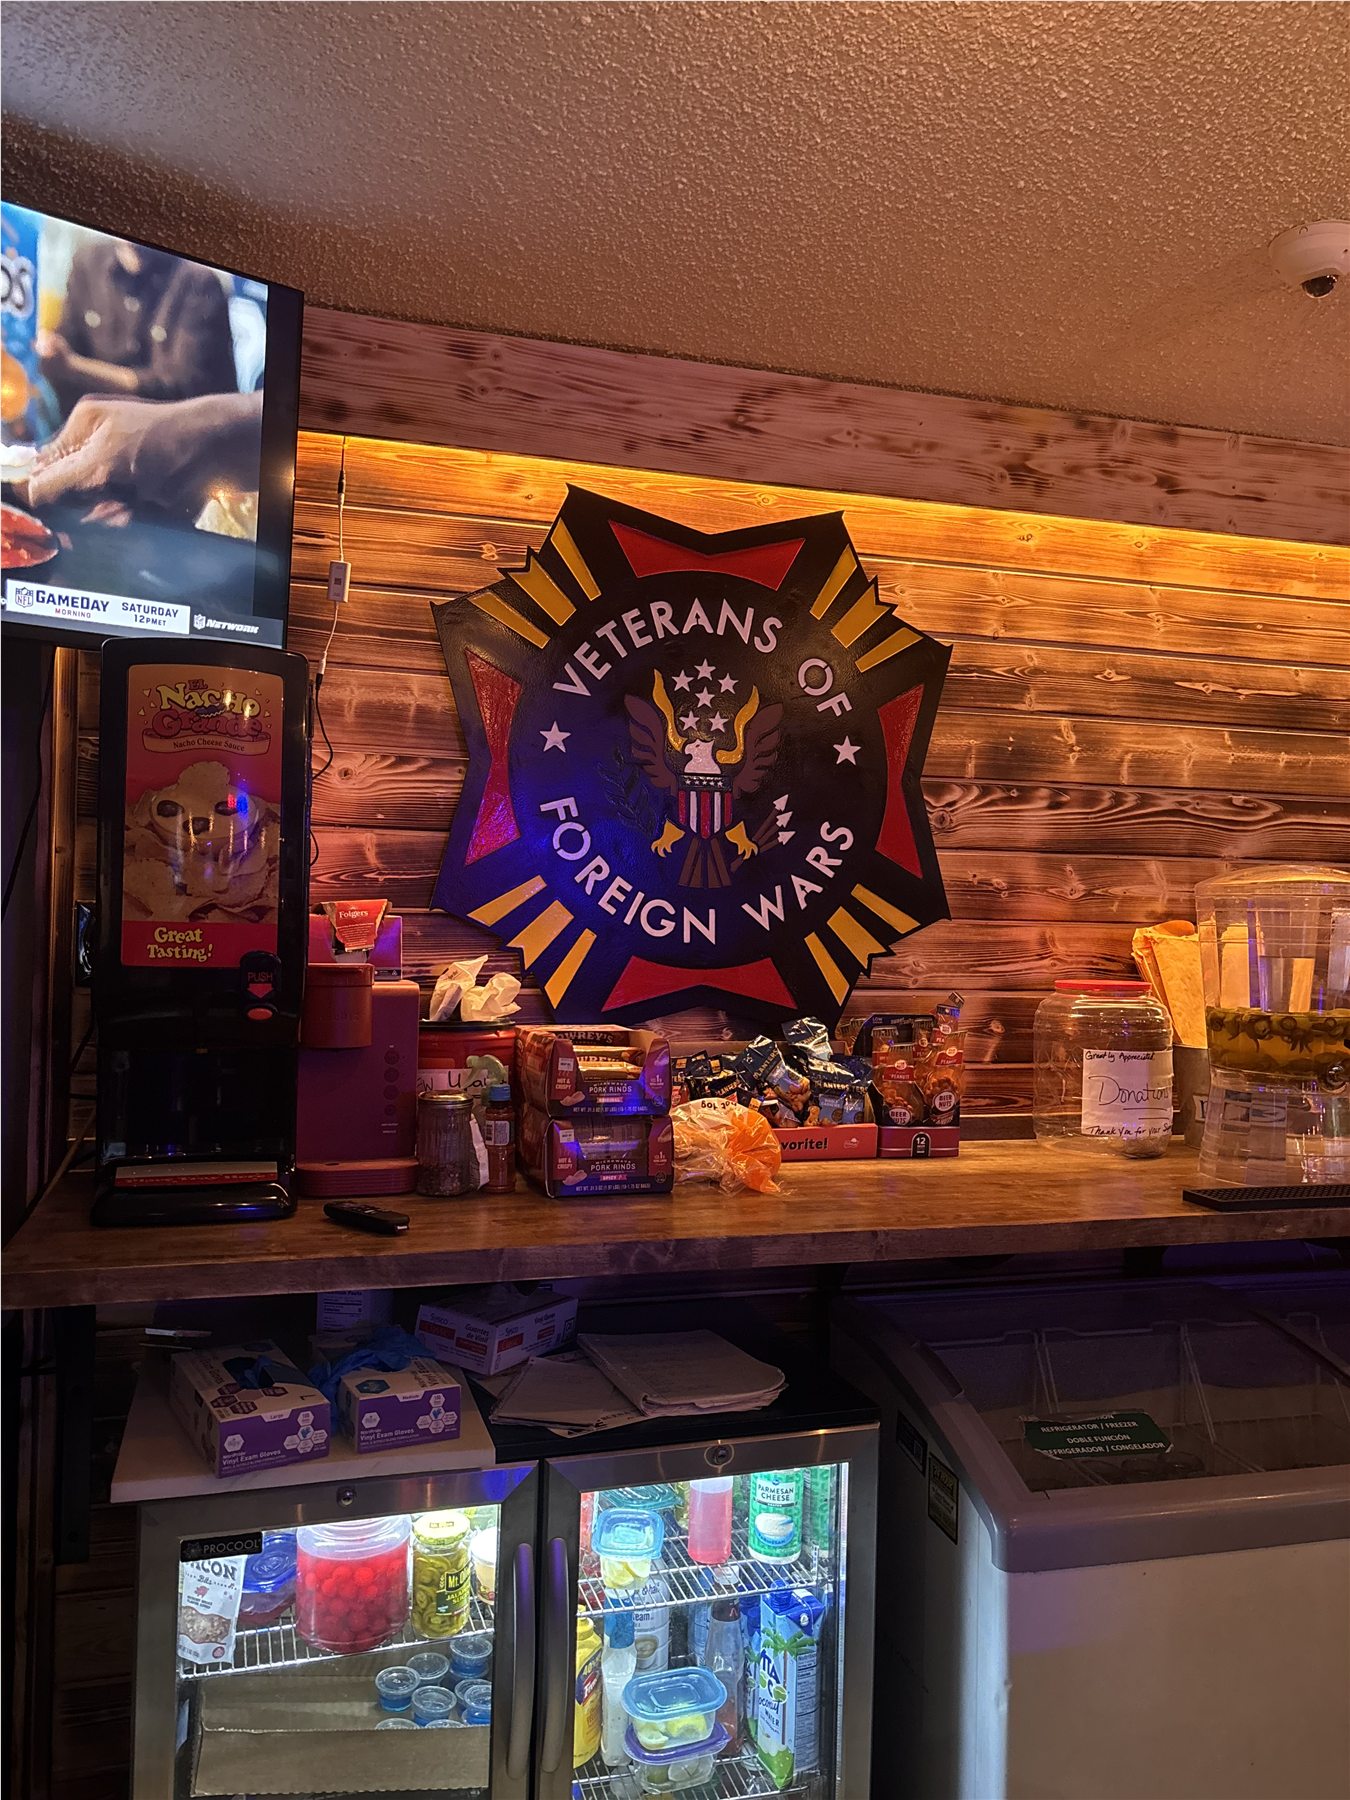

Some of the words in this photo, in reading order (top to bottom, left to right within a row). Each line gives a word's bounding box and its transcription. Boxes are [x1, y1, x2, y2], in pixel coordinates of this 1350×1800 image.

[36, 590, 109, 612] GAMEDAY
[55, 607, 91, 619] MORNING
[122, 601, 179, 618] SATURDAY
[552, 598, 783, 697] VETERANS
[798, 657, 852, 718] OF
[152, 709, 263, 738] Grande
[173, 739, 196, 750] Nacho
[197, 738, 223, 748] Cheese
[223, 740, 246, 752] Sauce
[539, 796, 716, 945] FOREIGN
[742, 821, 854, 931] WARS
[339, 910, 368, 919] Folgers
[153, 926, 203, 944] Great
[147, 943, 213, 963] Tasting!
[247, 971, 273, 982] PUSH
[1085, 1050, 1115, 1062] Greatly
[753, 1048, 780, 1079] PLANTERS
[609, 1085, 632, 1093] RINDS
[1086, 1125, 1116, 1136] Thank
[1135, 1126, 1146, 1137] for
[781, 1138, 828, 1150] vorite!
[916, 1137, 926, 1145] 12
[465, 1323, 490, 1337] Guantes
[466, 1332, 474, 1340] de
[1041, 1422, 1099, 1433] REFRIGERATOR
[1105, 1420, 1139, 1429] FREEZER
[360, 1433, 376, 1441] Vinyl
[376, 1431, 393, 1439] Exam
[394, 1428, 415, 1436] Gloves
[1066, 1436, 1093, 1444] DOBLE
[1093, 1433, 1131, 1442] FUNCIÓN
[1111, 1441, 1166, 1452] CONGELADOR
[222, 1457, 239, 1466] Vinyl
[240, 1454, 258, 1462] Exam
[259, 1450, 282, 1458] Gloves
[758, 1484, 794, 1495] PARMESAN
[761, 1492, 790, 1502] CHEESE
[203, 1539, 260, 1554] PROCOOL
[448, 1575, 460, 1588] Mt.
